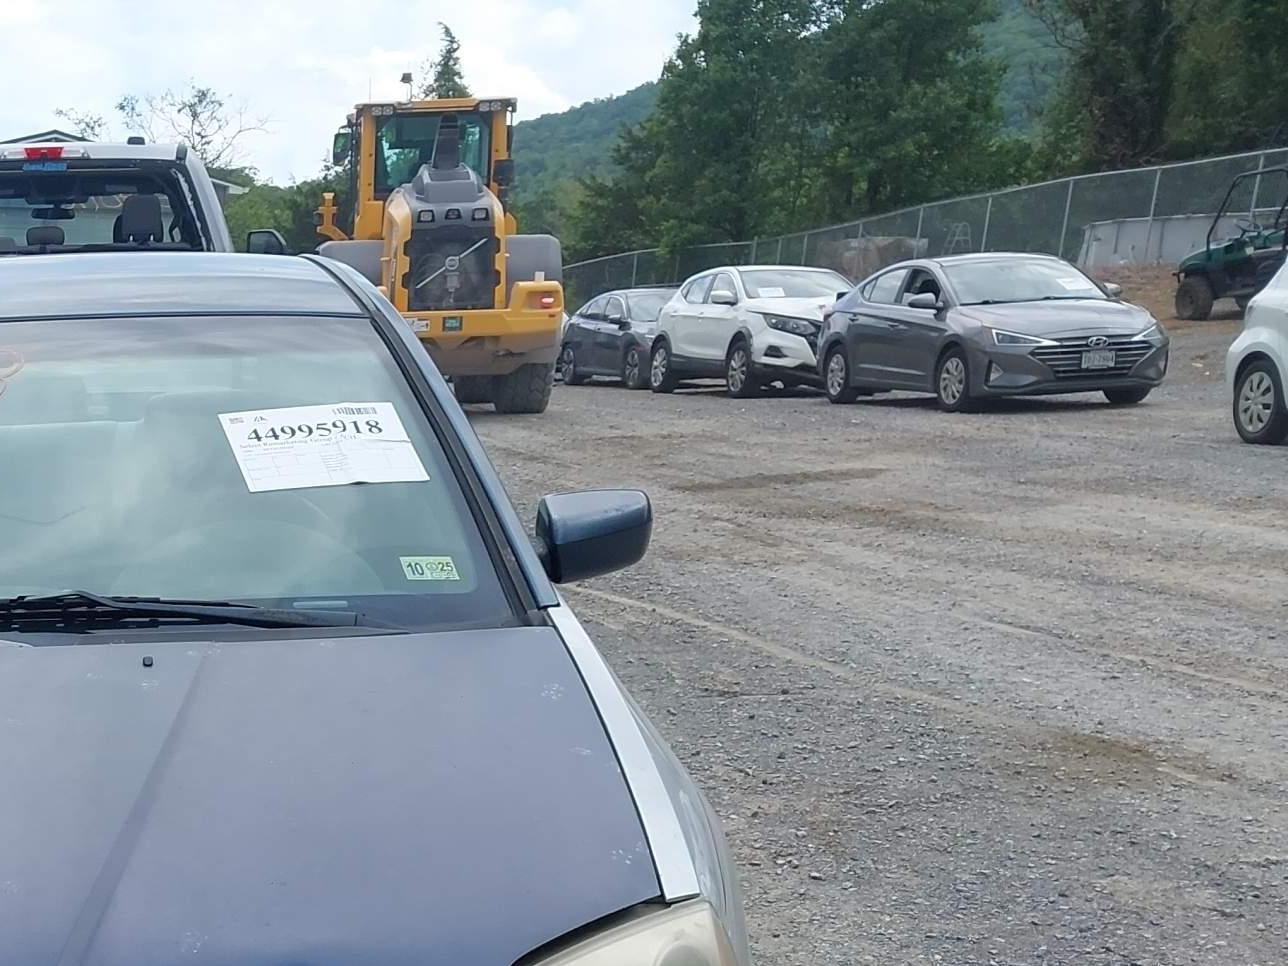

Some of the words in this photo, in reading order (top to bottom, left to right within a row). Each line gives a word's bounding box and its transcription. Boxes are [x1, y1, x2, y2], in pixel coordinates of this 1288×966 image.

[247, 419, 383, 442] 44995918
[406, 562, 425, 576] 10
[437, 561, 454, 572] 25
